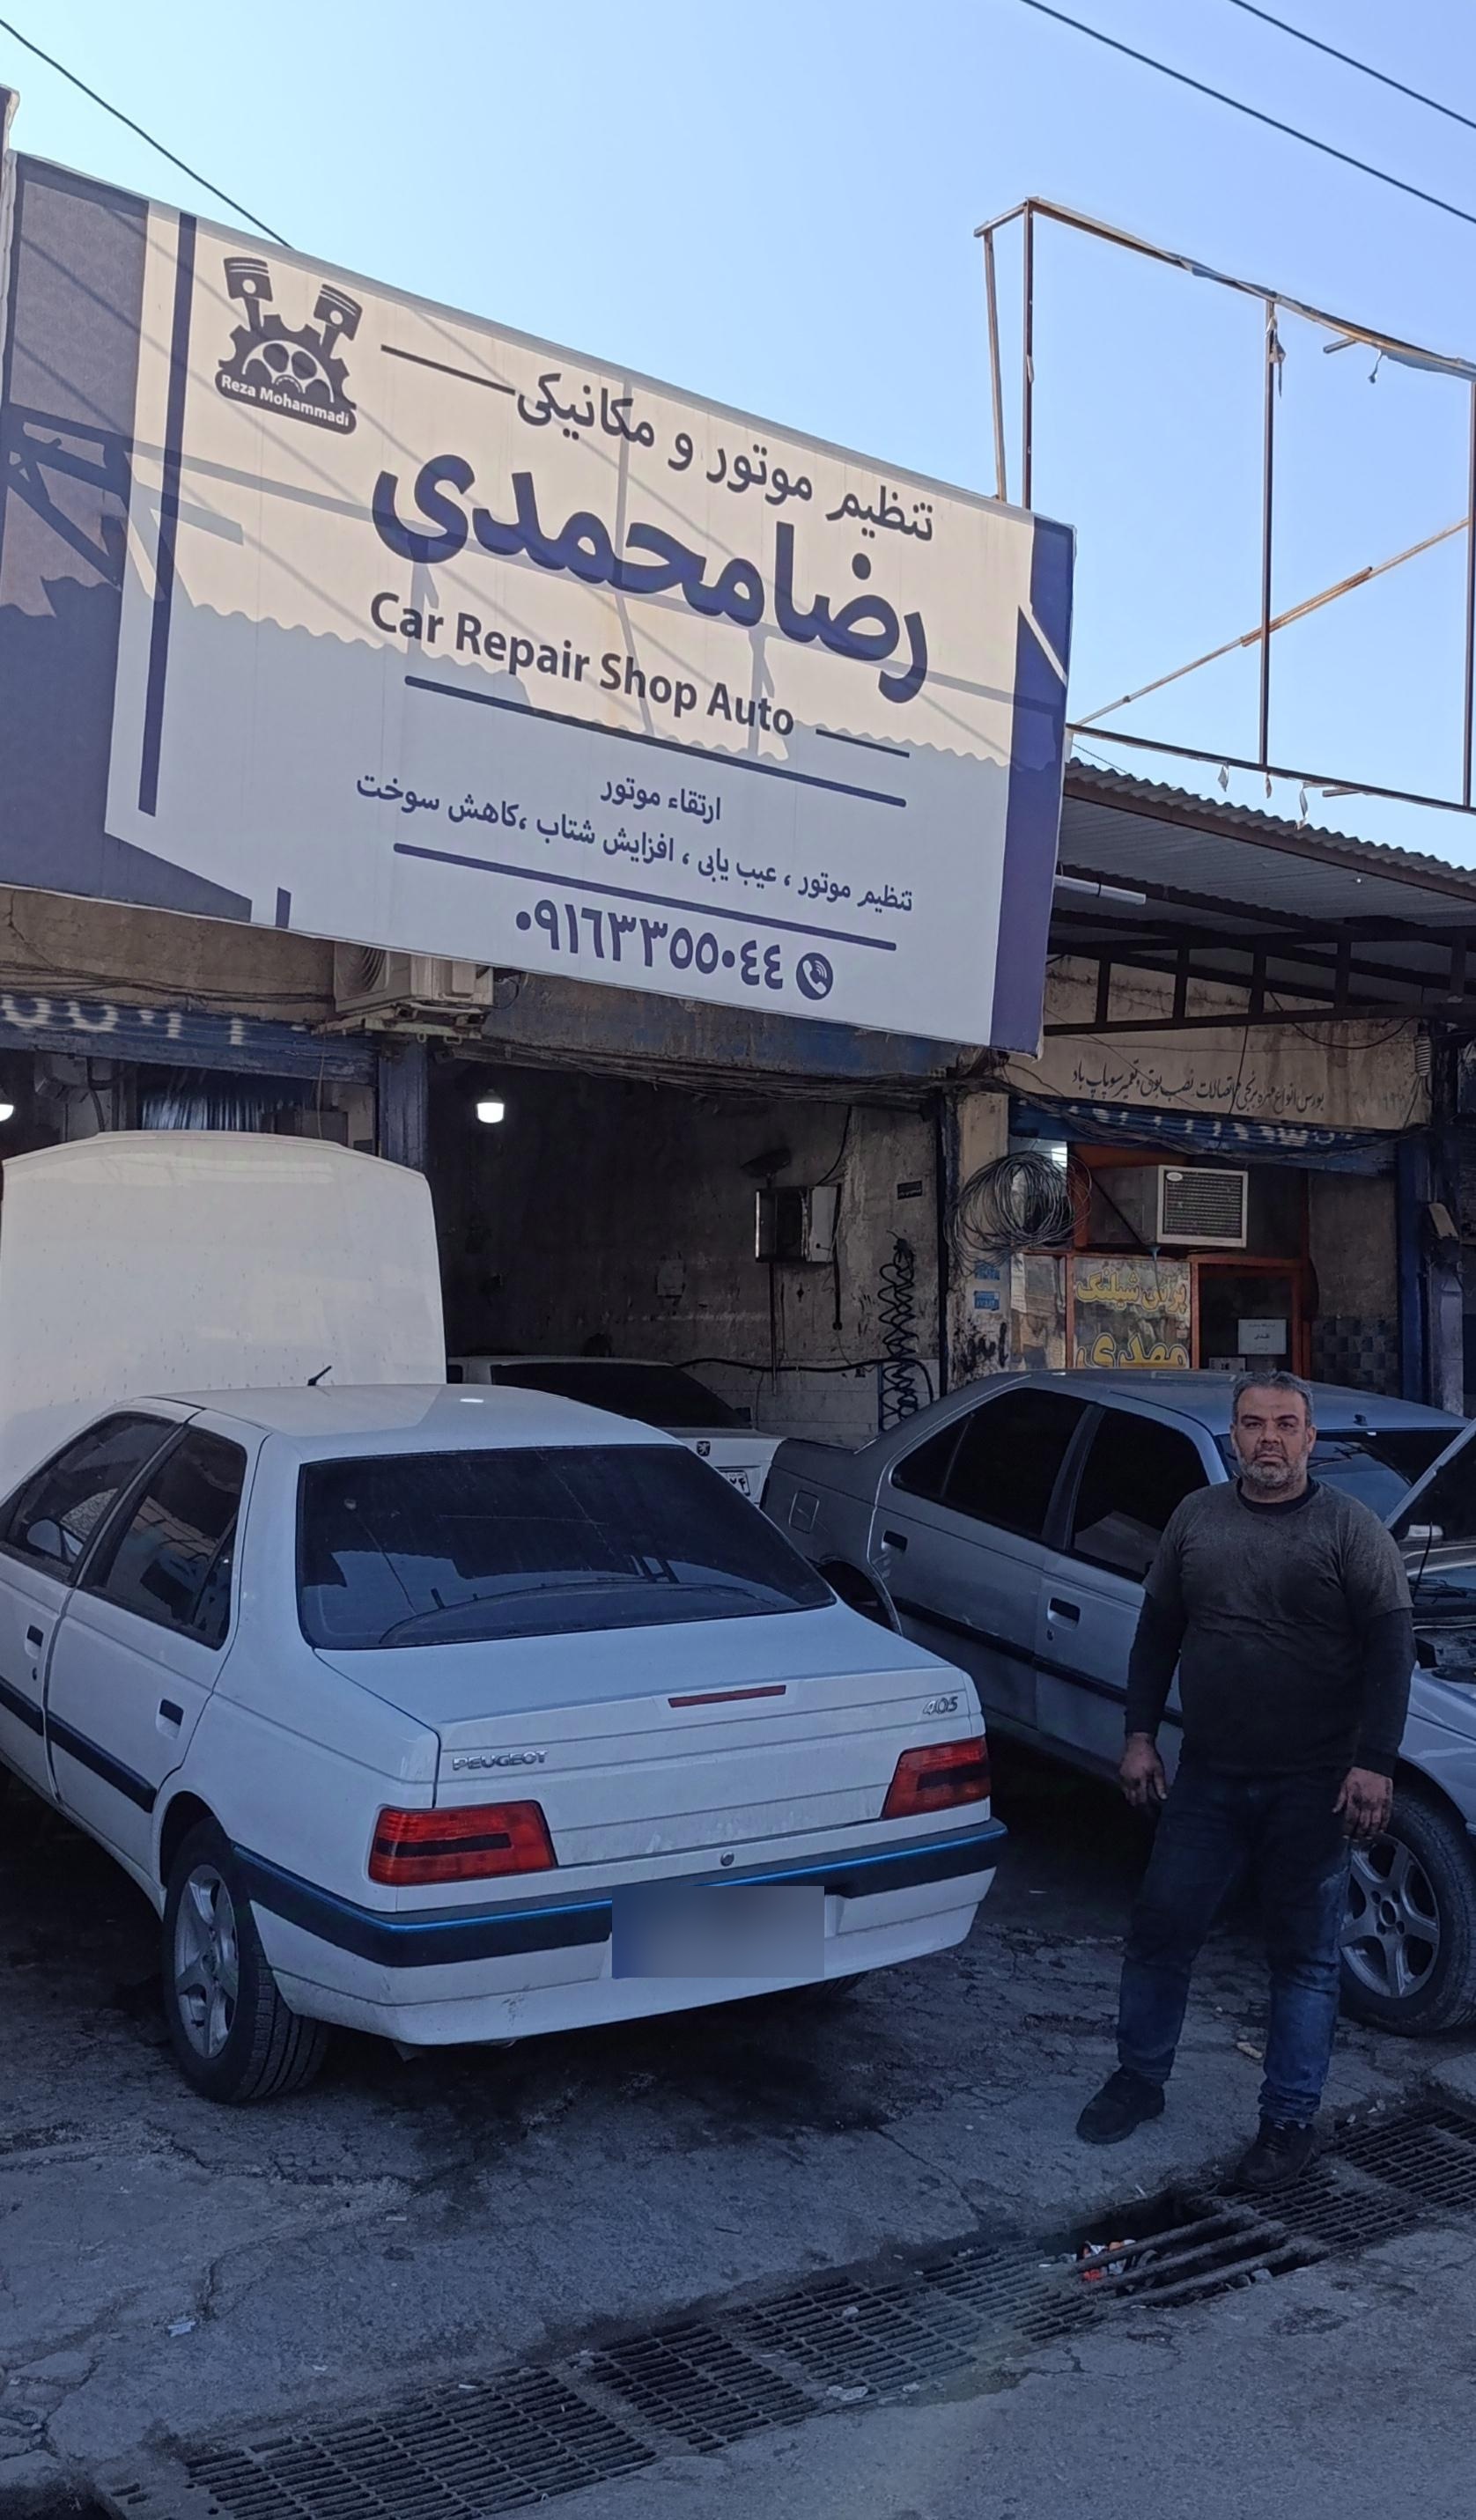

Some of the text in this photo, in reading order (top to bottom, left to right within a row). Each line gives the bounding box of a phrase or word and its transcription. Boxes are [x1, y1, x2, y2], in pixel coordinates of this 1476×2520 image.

[221, 374, 350, 426] Reza Mohammadi
[517, 372, 934, 540] تنظیم موتور و مکانیکی
[371, 592, 793, 735] Car Repair Shop Auto
[357, 775, 439, 813] سوخت
[600, 777, 721, 824] ارتقاء موتور
[536, 814, 595, 844] شتاب
[602, 828, 674, 864] افزایش
[697, 848, 728, 882] یابی
[736, 862, 777, 889] عیب
[798, 872, 851, 903] موتور
[857, 884, 912, 913] تنظیم
[922, 1696, 959, 1715] 405
[453, 1750, 548, 1771] PEUGEOT
